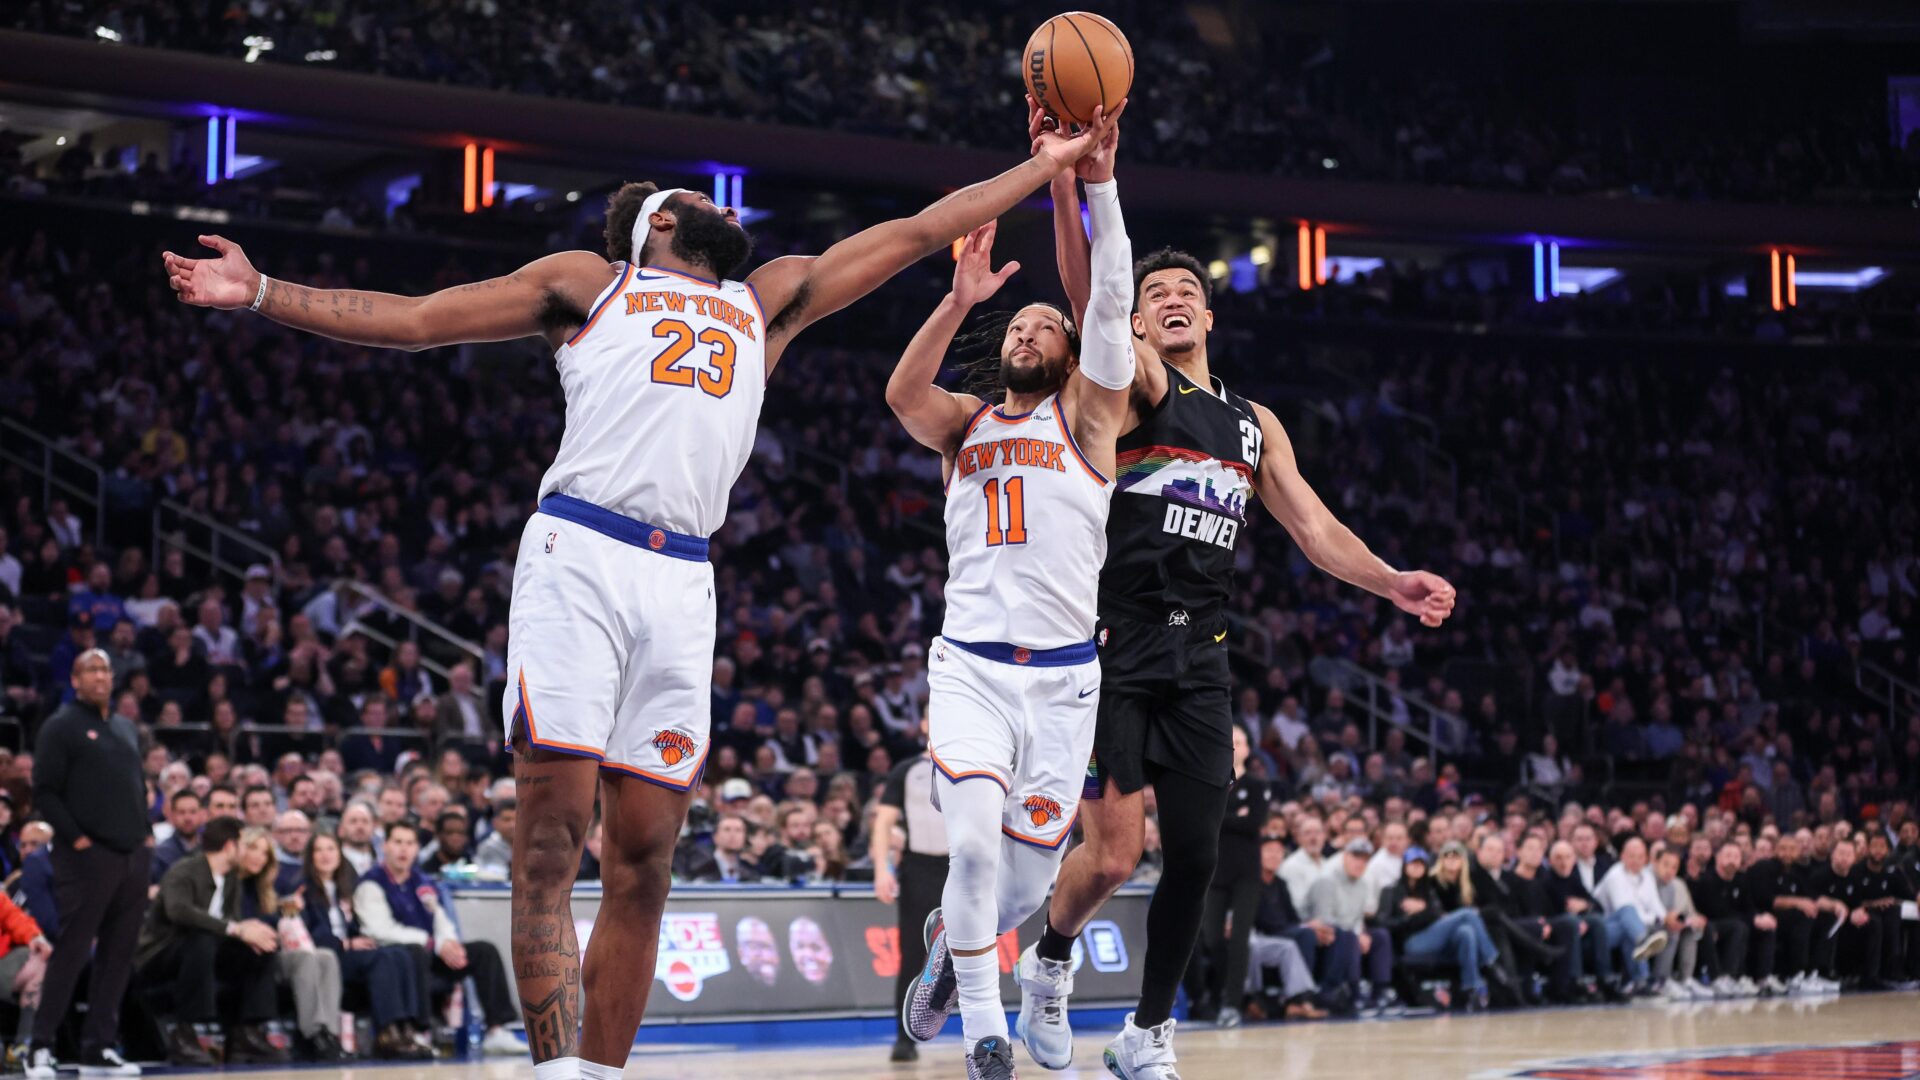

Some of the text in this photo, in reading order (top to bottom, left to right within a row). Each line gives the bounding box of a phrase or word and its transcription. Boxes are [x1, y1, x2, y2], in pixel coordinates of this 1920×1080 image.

[625, 291, 756, 341] NEW YORK
[651, 318, 736, 399] 23
[957, 438, 1066, 481] NEW YORK
[983, 476, 1027, 547] 11
[1162, 503, 1238, 551] DENVER
[652, 730, 694, 757] KNICKS
[1023, 795, 1061, 819] KNICKS
